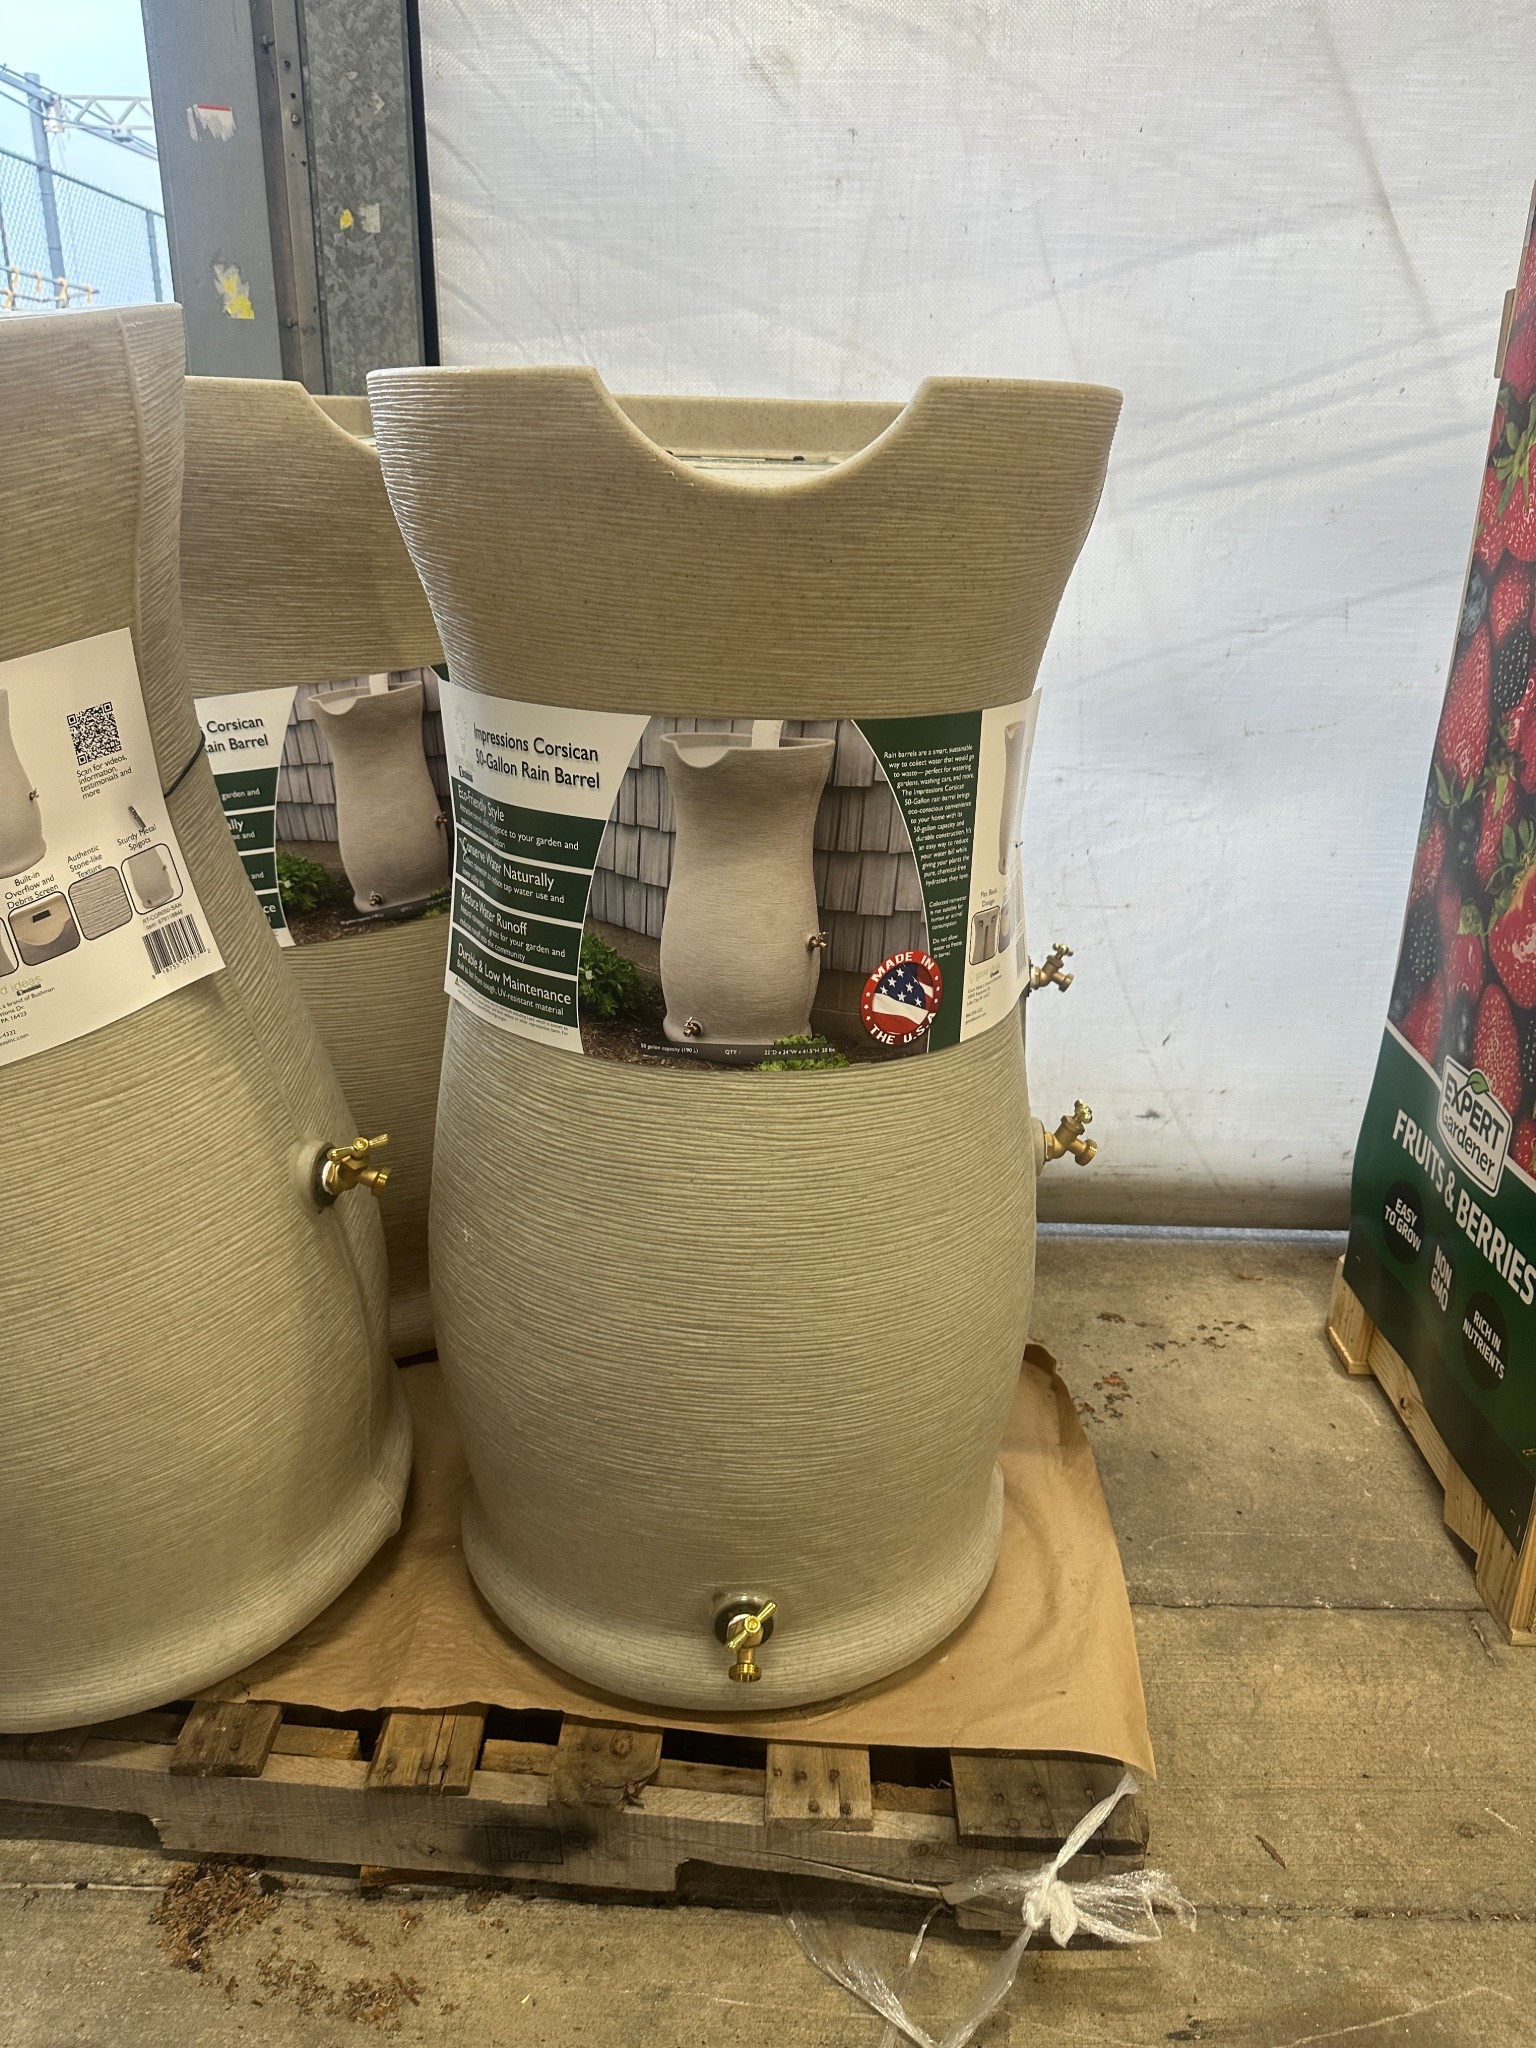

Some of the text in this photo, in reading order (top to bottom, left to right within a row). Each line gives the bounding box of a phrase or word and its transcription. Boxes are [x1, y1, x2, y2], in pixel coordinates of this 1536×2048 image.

[207, 718, 263, 733] Corsican
[205, 734, 268, 753] ain Barrel
[473, 723, 598, 761] Impressions Corsican
[949, 744, 972, 753] sustainable
[77, 768, 92, 777] Scan
[105, 755, 127, 766] videos,
[476, 749, 517, 776] 50-Gallon
[522, 762, 549, 782] Rain
[555, 767, 600, 788] Barrel
[925, 768, 942, 776] perfect
[81, 767, 132, 793] testimonials and
[83, 789, 100, 799] more
[222, 788, 260, 801] garden and
[914, 787, 943, 795] Impressions
[488, 802, 504, 822] Style
[908, 801, 971, 814] eco-conscious convenience
[117, 824, 156, 845] Sturdy Metal
[914, 825, 936, 833] 50-gallon
[937, 822, 955, 830] capacity
[129, 837, 151, 851] Spigots
[518, 833, 534, 842] your
[536, 837, 561, 847] garden
[564, 842, 579, 850] and
[67, 845, 99, 863] Authentic
[70, 854, 103, 872] Stone-like
[922, 862, 936, 870] giving
[949, 857, 961, 865] plants
[15, 872, 40, 886] Built-in
[77, 864, 102, 878] Texture
[486, 852, 501, 873] Water
[504, 864, 554, 891] Naturally
[937, 865, 966, 875] chemical-free
[5, 874, 54, 899] Overflow and
[926, 878, 947, 887] hydration
[7, 884, 58, 909] Debris Screen
[504, 884, 564, 903] tap water use and
[929, 899, 948, 907] Collected
[462, 887, 478, 911] Reduce
[479, 900, 495, 922] Water
[497, 913, 527, 935] Runoff
[495, 945, 525, 962] community
[500, 932, 565, 957] for your garden and
[458, 943, 571, 1004] Durable & Low Maintenance
[871, 952, 934, 983] MADE IN
[12, 976, 41, 992] ideas
[7, 998, 23, 1007] brand
[31, 987, 55, 998] Bushman
[498, 987, 533, 1007] UV-resistant
[535, 1003, 563, 1015] material
[10, 1011, 27, 1020] 16423
[870, 1024, 895, 1044] THE
[1445, 1072, 1504, 1150] EXPERT
[1442, 1103, 1495, 1176] Gardener
[1393, 1109, 1536, 1304] FRUITS & BERRIES
[1395, 1198, 1417, 1227] EASY
[1385, 1205, 1422, 1251] TO GROW
[1434, 1245, 1452, 1289] NON
[1431, 1268, 1448, 1312] GMO
[1474, 1310, 1501, 1352] RICH IN
[1462, 1318, 1504, 1379] NUTRIENTS
